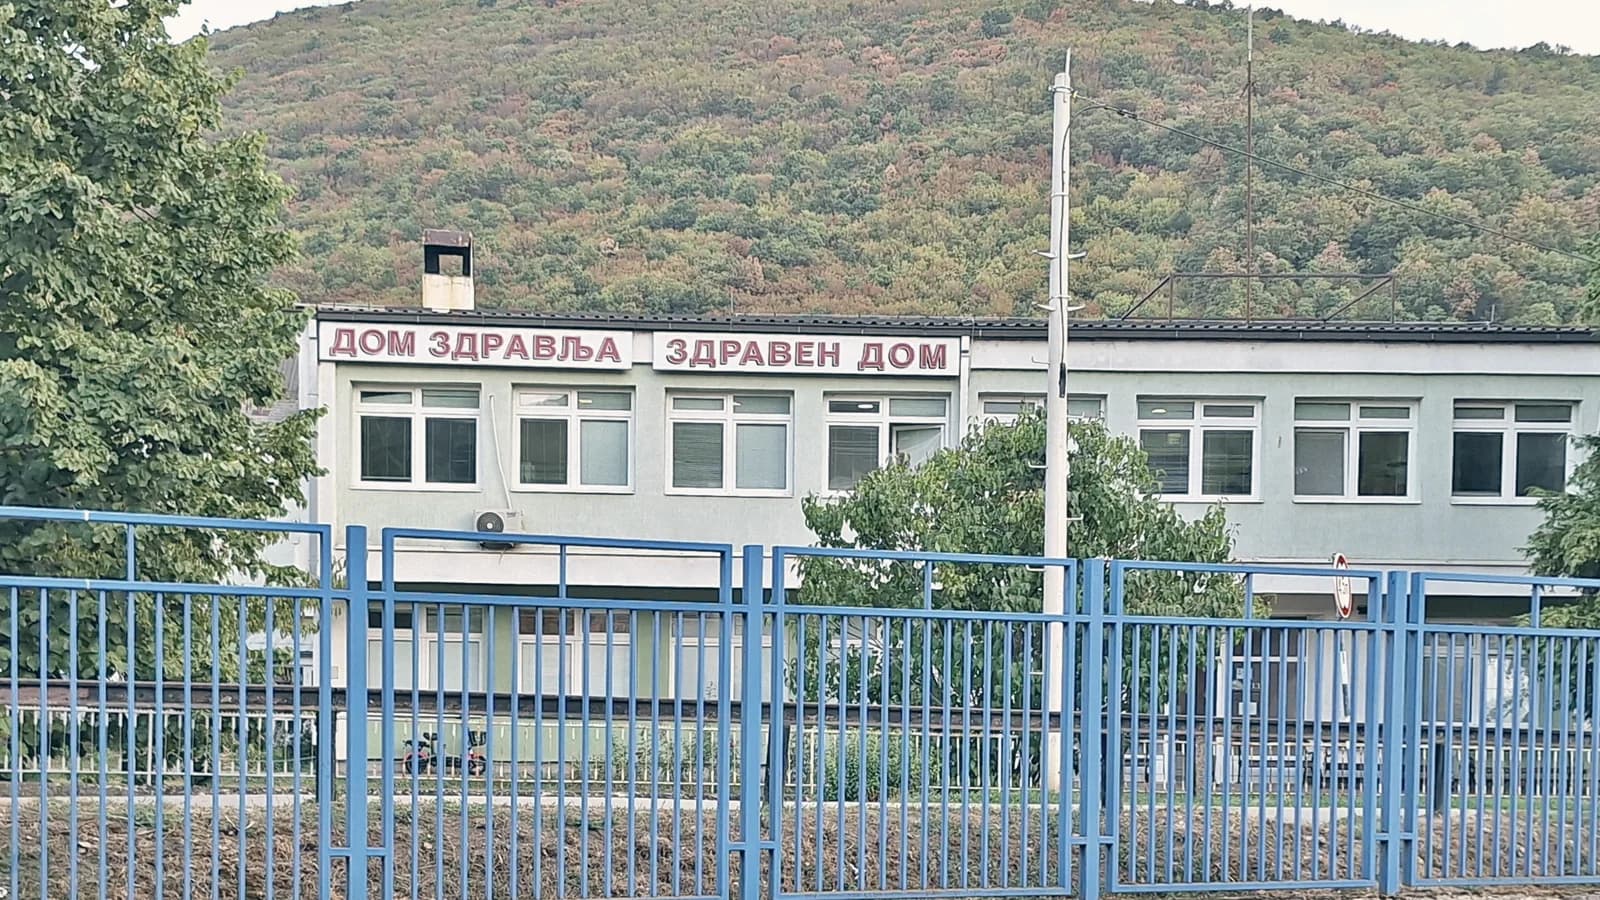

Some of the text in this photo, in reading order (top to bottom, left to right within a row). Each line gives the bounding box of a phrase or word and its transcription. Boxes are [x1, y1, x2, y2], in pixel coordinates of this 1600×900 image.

[329, 327, 622, 363] ДОМ ЗДРАВЉА
[666, 338, 948, 371] ЗДРАВЕН ДОМ
